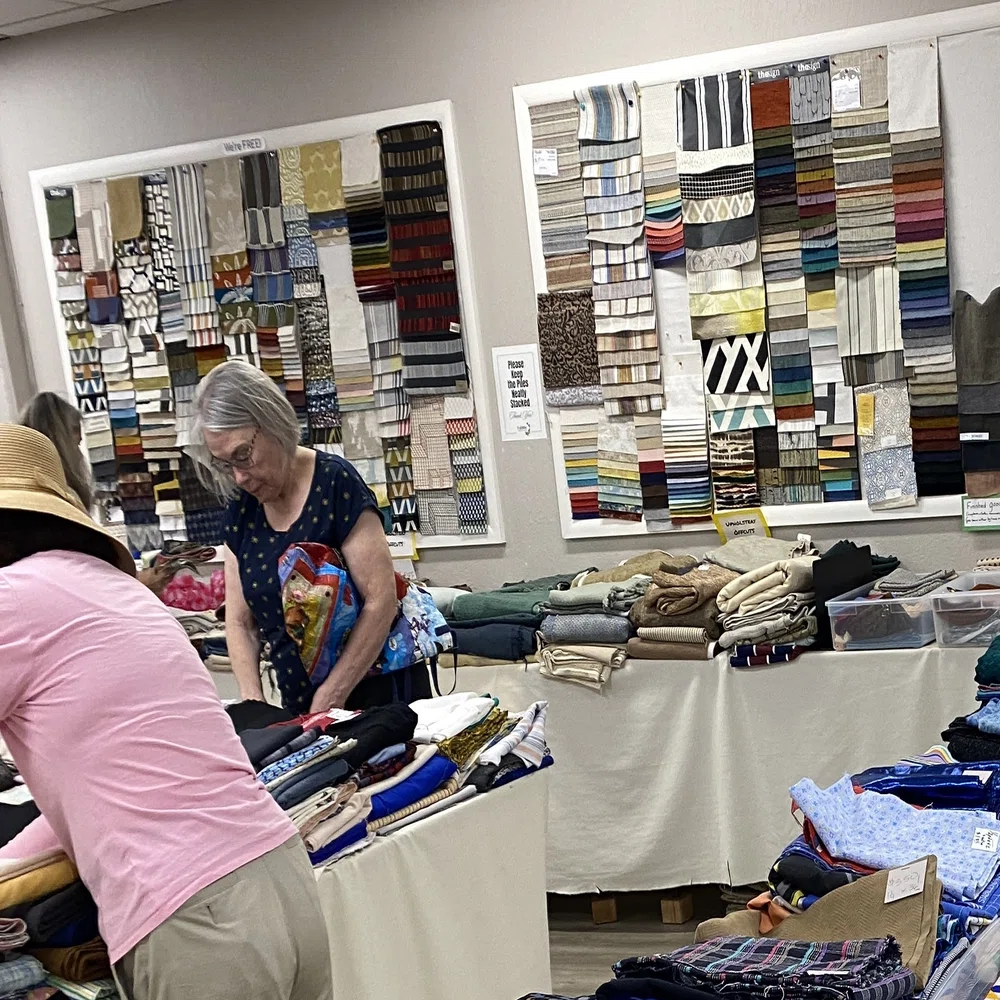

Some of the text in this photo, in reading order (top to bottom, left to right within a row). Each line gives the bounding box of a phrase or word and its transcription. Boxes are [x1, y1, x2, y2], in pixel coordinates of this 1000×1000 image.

[507, 360, 524, 370] Please
[511, 370, 523, 380] Keep
[507, 379, 529, 389] the Piles
[511, 389, 527, 399] Neatly
[510, 398, 531, 408] Stacked
